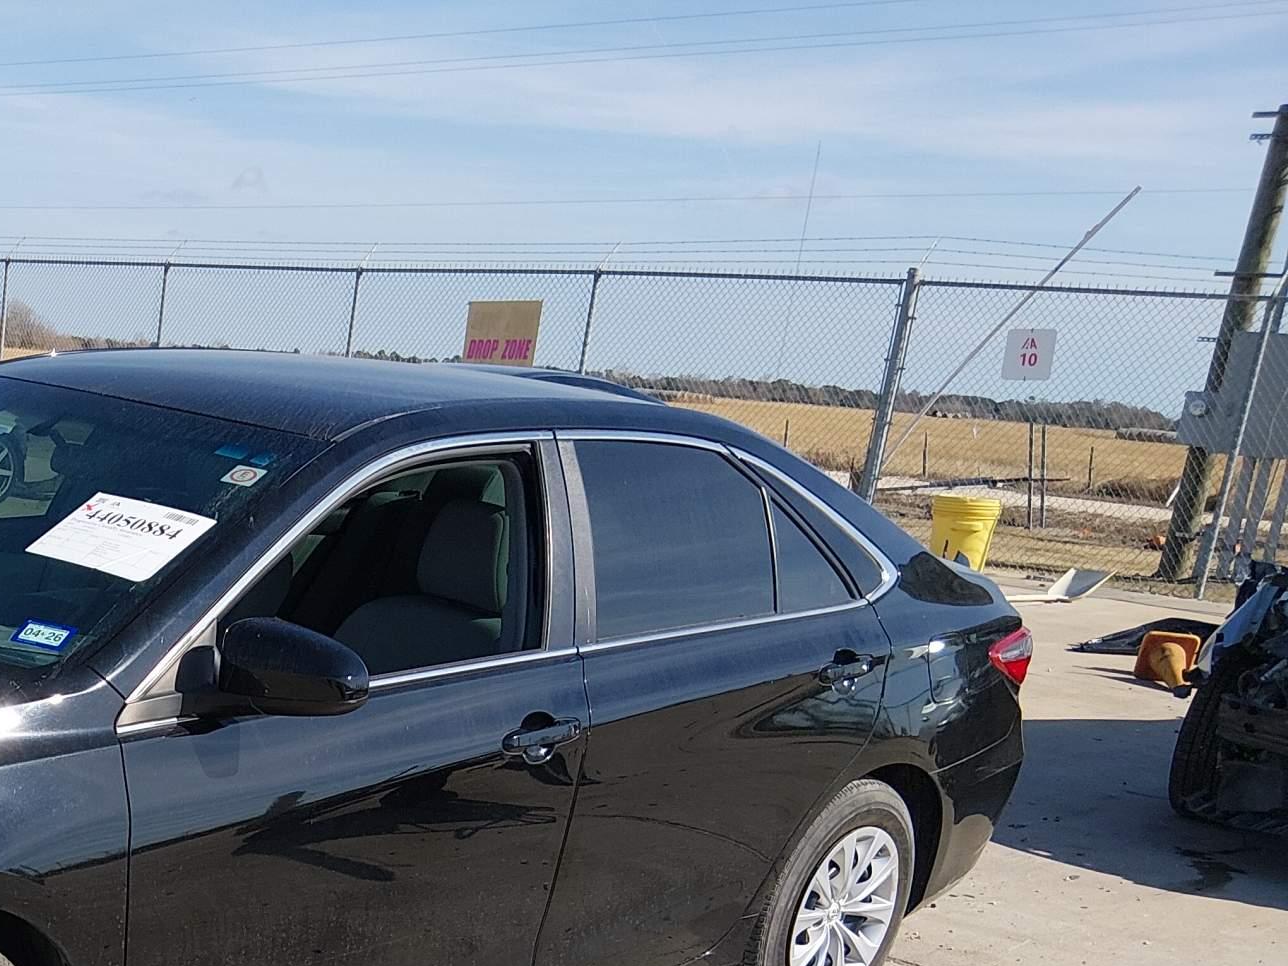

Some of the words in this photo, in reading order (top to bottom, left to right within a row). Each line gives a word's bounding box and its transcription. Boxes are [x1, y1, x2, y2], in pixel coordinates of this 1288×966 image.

[467, 338, 499, 360] DROP
[501, 338, 532, 360] ZONE
[1020, 352, 1038, 367] 10
[85, 509, 184, 540] 44050884
[23, 627, 42, 638] 04
[44, 631, 64, 642] 26
